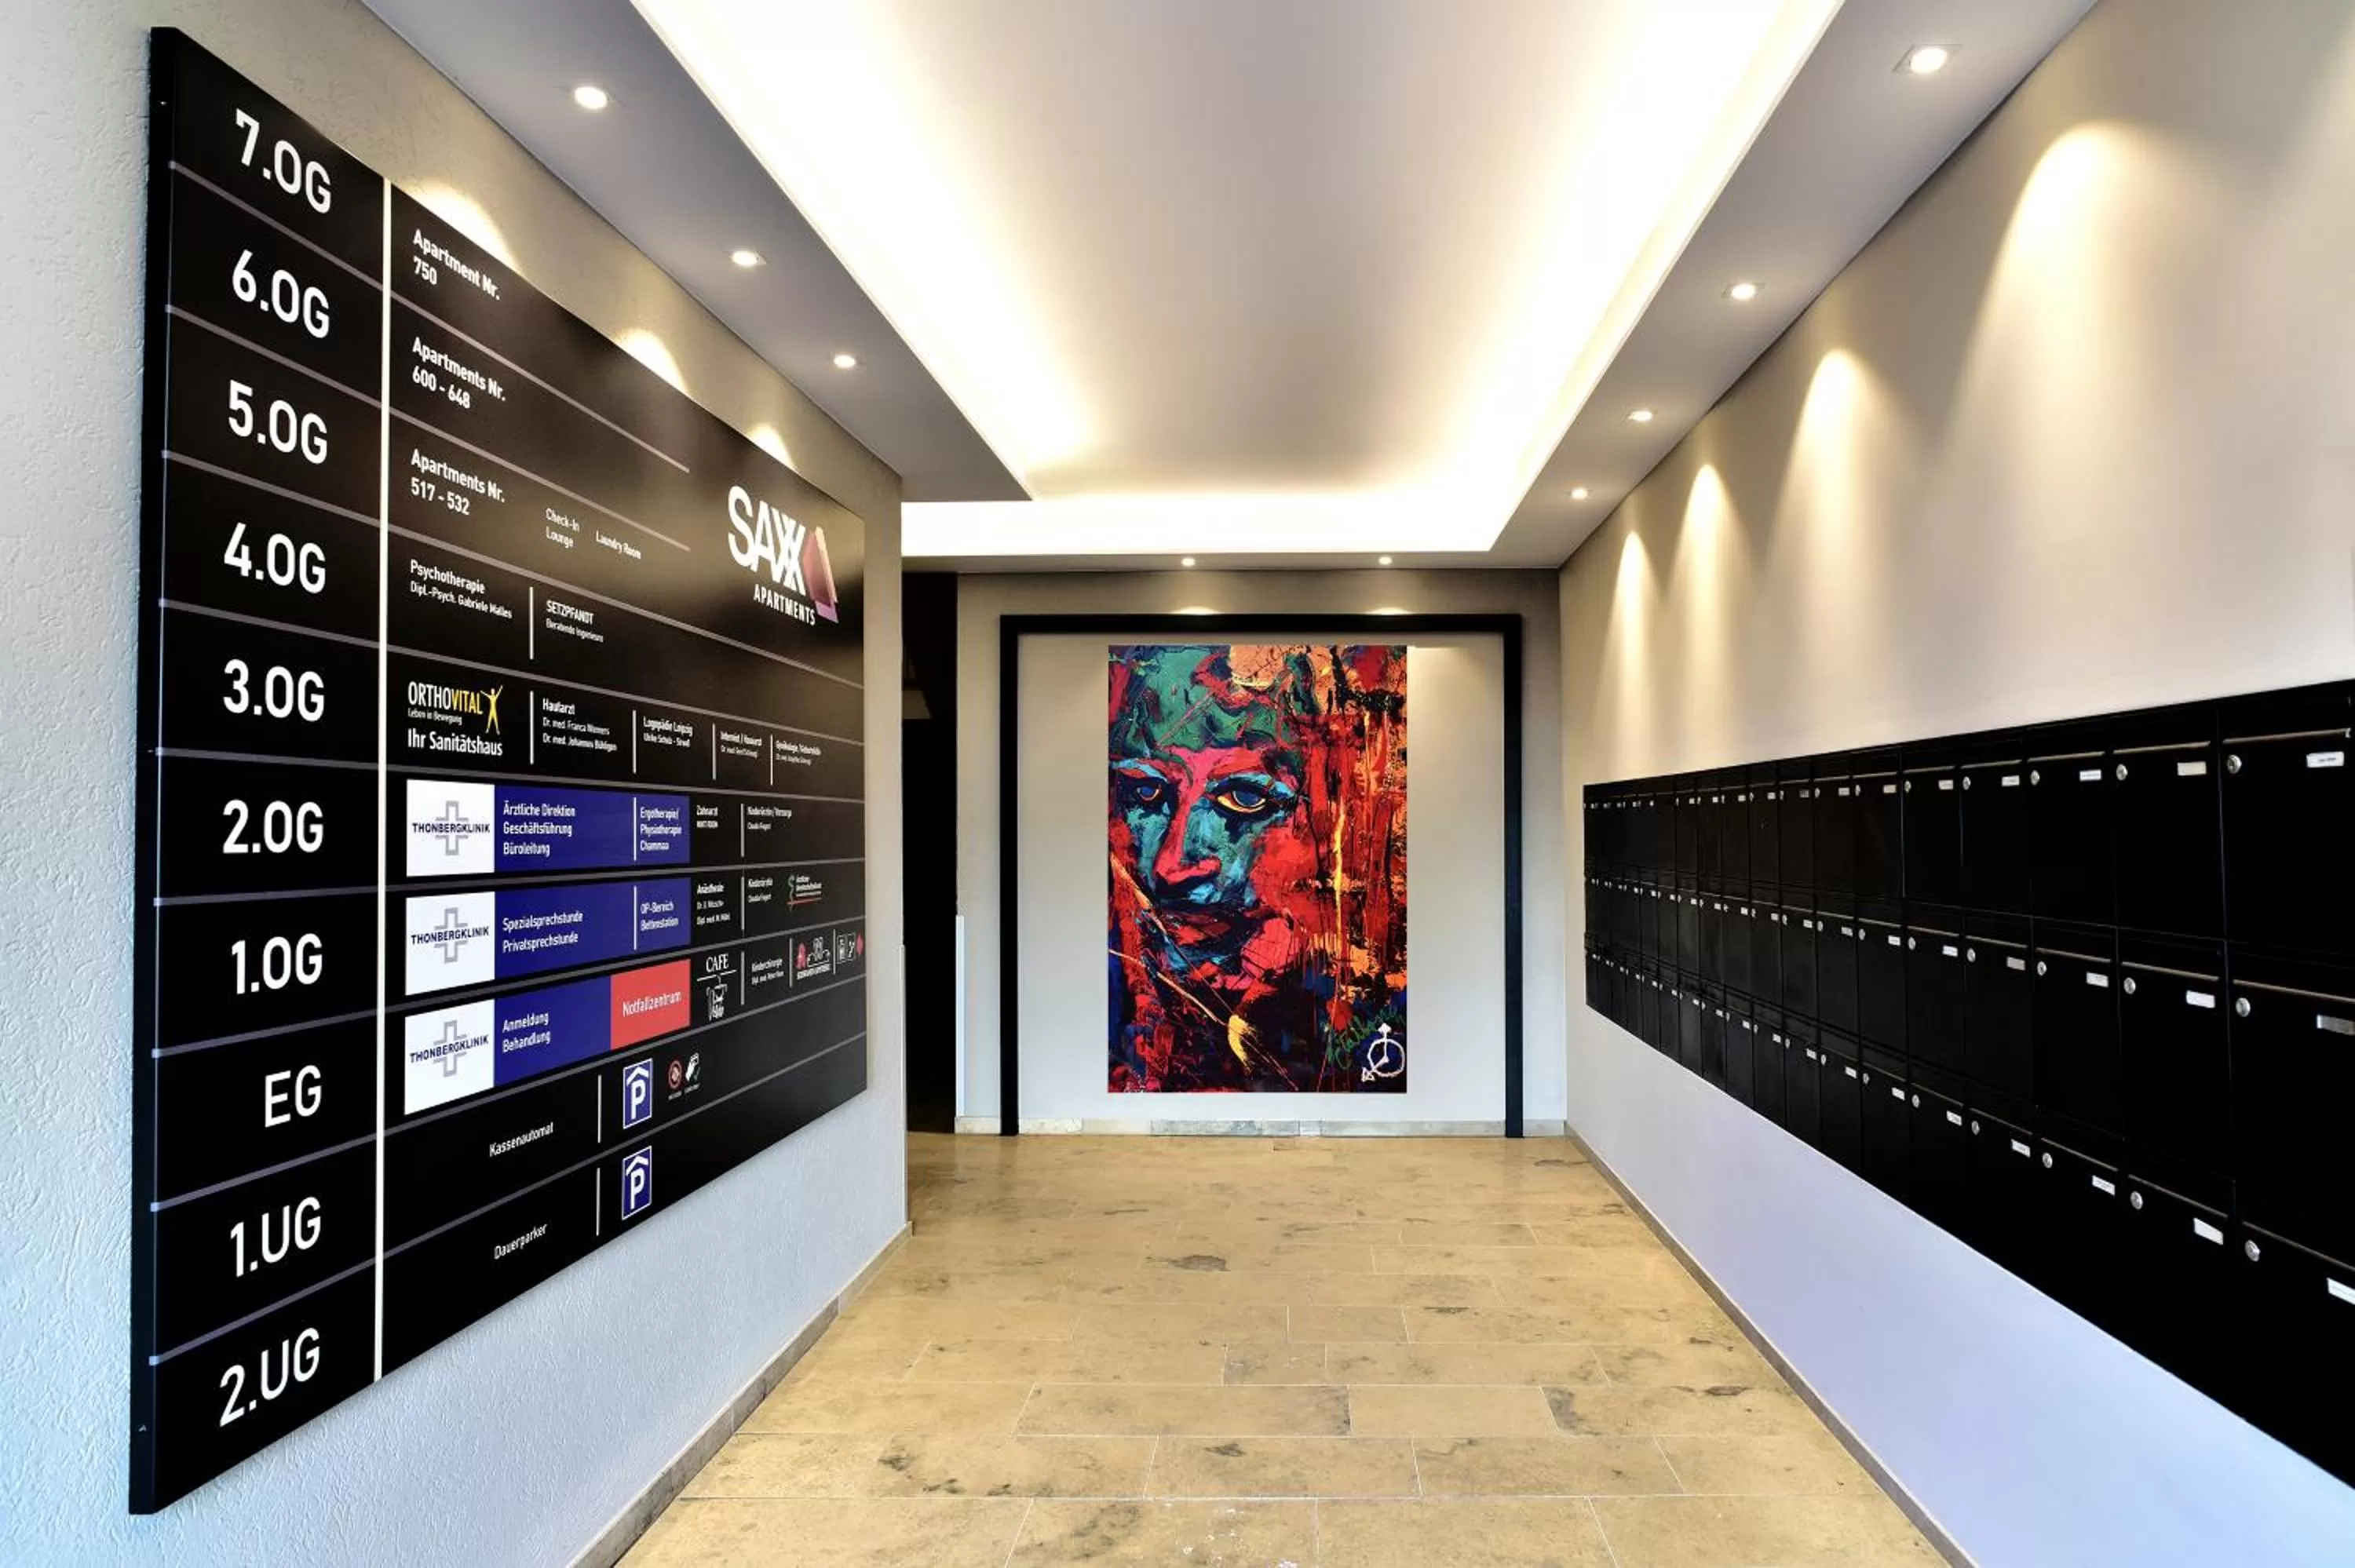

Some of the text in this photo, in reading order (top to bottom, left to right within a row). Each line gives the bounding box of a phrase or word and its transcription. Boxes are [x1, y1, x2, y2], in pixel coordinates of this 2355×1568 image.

[236, 109, 331, 214] 7.OG
[413, 228, 500, 301] Apartment Nr.
[413, 256, 437, 285] 750
[232, 250, 329, 338] 6.OG
[412, 337, 506, 401] Apartments Nr.
[412, 365, 436, 392] 600
[448, 384, 470, 409] 648
[228, 380, 327, 464] 5.OG
[411, 449, 505, 502] Apartments Nr.
[411, 476, 435, 501] 517
[447, 490, 469, 515] 532
[546, 526, 574, 548] Lounge
[224, 522, 326, 594] 4.OG
[411, 559, 485, 594] Psychotherapie
[754, 583, 816, 625] APARTMENTS
[223, 659, 325, 722] 3.OG
[407, 681, 483, 715] ORTHOVITAL
[407, 728, 503, 756] Ihr Sanitätshaus
[223, 800, 324, 854] 2.OG
[502, 800, 575, 817] Ärztliche Direktion
[412, 822, 491, 833] THONBERGKLINIK
[503, 821, 572, 837] Geschäftsführung
[503, 841, 550, 857] Büroleitung
[411, 926, 490, 945] THONBERGKLINIK
[502, 910, 584, 933] Spezialsprechstunde
[502, 931, 579, 954] Privatsprechstunde
[231, 932, 323, 994] 1.OG
[706, 953, 729, 972] CAFE
[622, 990, 682, 1017] Notfallzentrum
[502, 1012, 550, 1033] Anmeldung
[409, 1034, 489, 1063] THONBERGKLINIK
[502, 1030, 551, 1053] Behandlung
[265, 1065, 322, 1129] EG
[630, 1079, 646, 1120] P
[489, 1121, 553, 1157] Kassenautomat
[630, 1167, 645, 1209] P
[230, 1195, 321, 1278] 1.UG
[494, 1223, 547, 1260] Dauerparker
[219, 1328, 320, 1428] 2.UG
